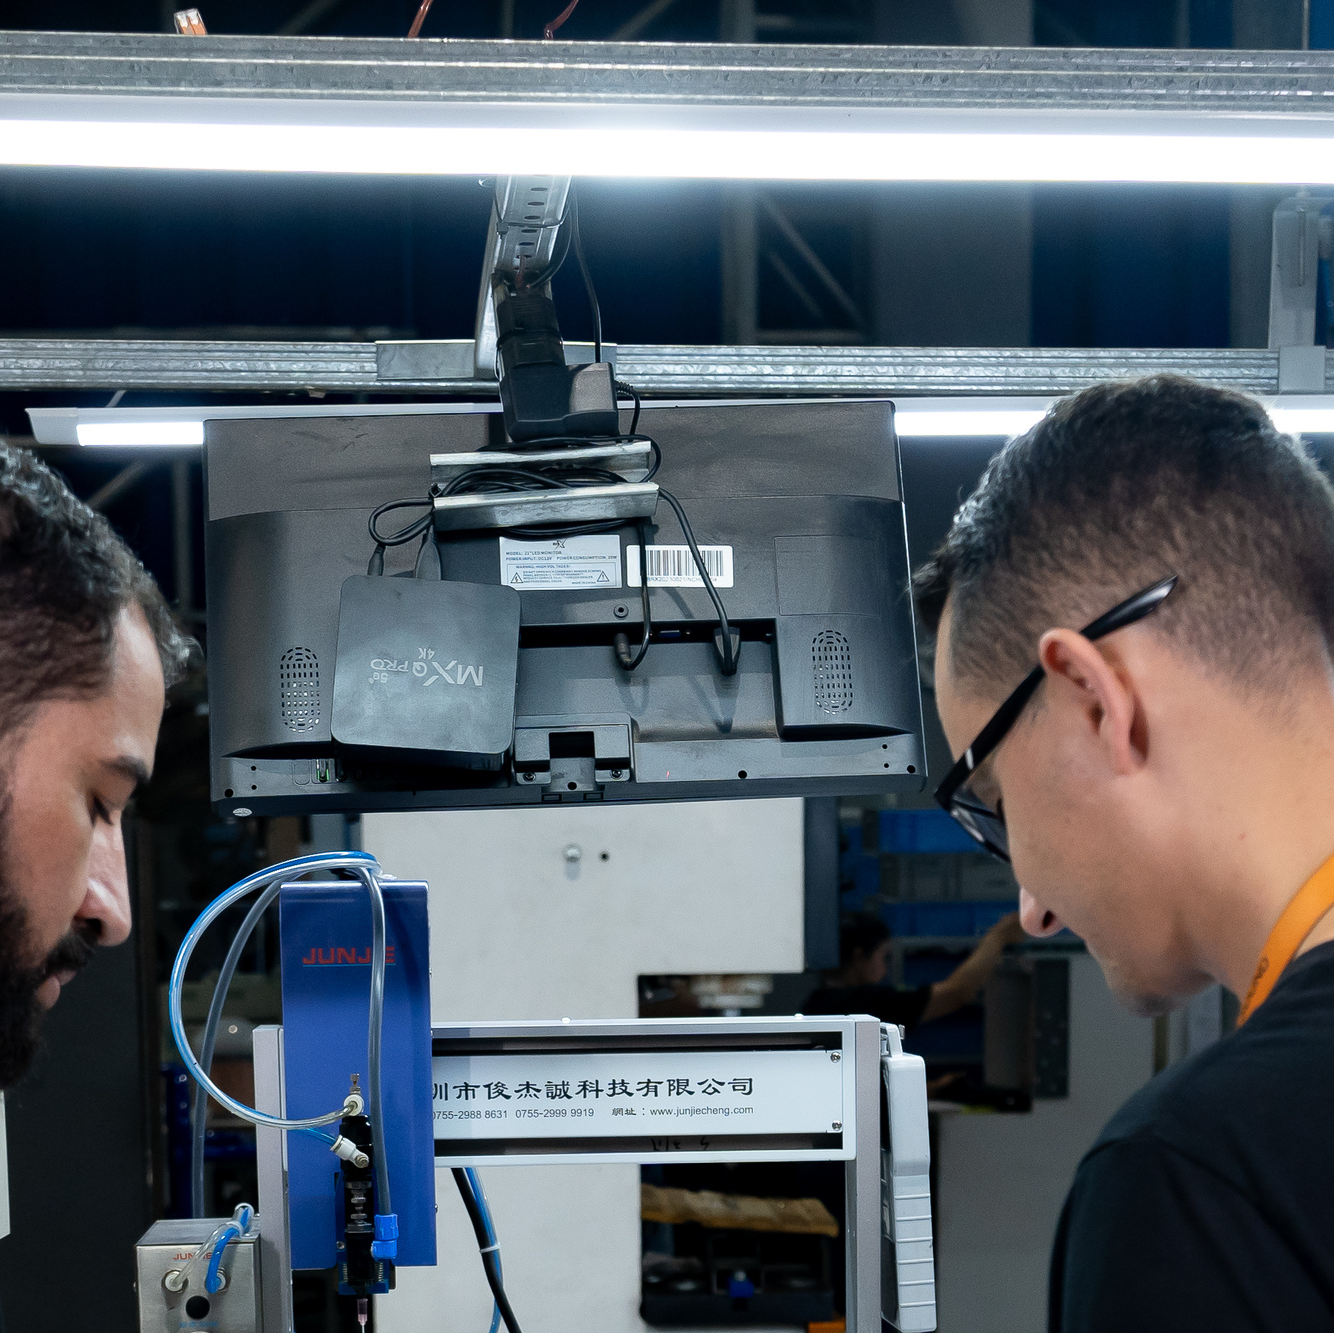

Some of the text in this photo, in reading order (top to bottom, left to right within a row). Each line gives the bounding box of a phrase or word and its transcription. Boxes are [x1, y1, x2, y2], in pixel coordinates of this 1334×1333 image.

[418, 647, 435, 659] 4K
[370, 658, 409, 672] PRO
[301, 945, 396, 965] JUNJE
[484, 1108, 508, 1119] 8631
[515, 1107, 567, 1119] 0755-2999
[570, 1107, 594, 1118] 9919
[650, 1105, 754, 1117] www.junjiecheng.com
[173, 1251, 213, 1261] JUNIE
